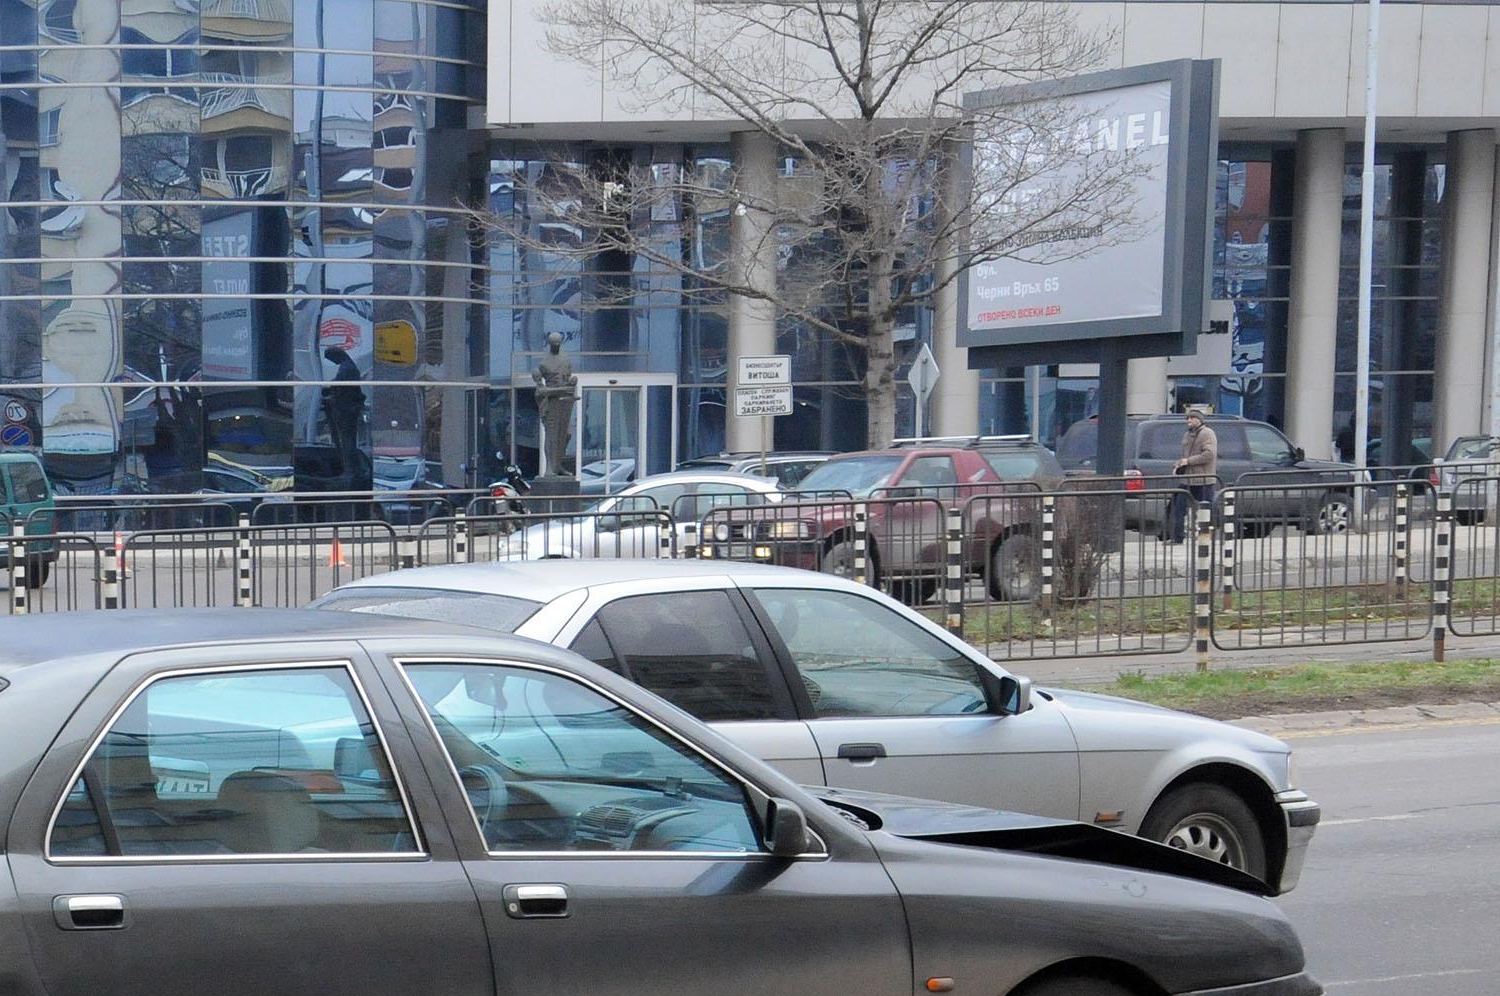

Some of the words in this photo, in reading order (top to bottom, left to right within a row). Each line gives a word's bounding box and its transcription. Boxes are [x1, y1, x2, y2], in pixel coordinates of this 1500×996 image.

[976, 286, 1011, 301] Черни
[1013, 281, 1041, 297] Връх
[1044, 277, 1060, 292] 65
[978, 310, 1016, 322] ОТВОРЕНО
[741, 405, 786, 414] ЗАБРАНЕНО
